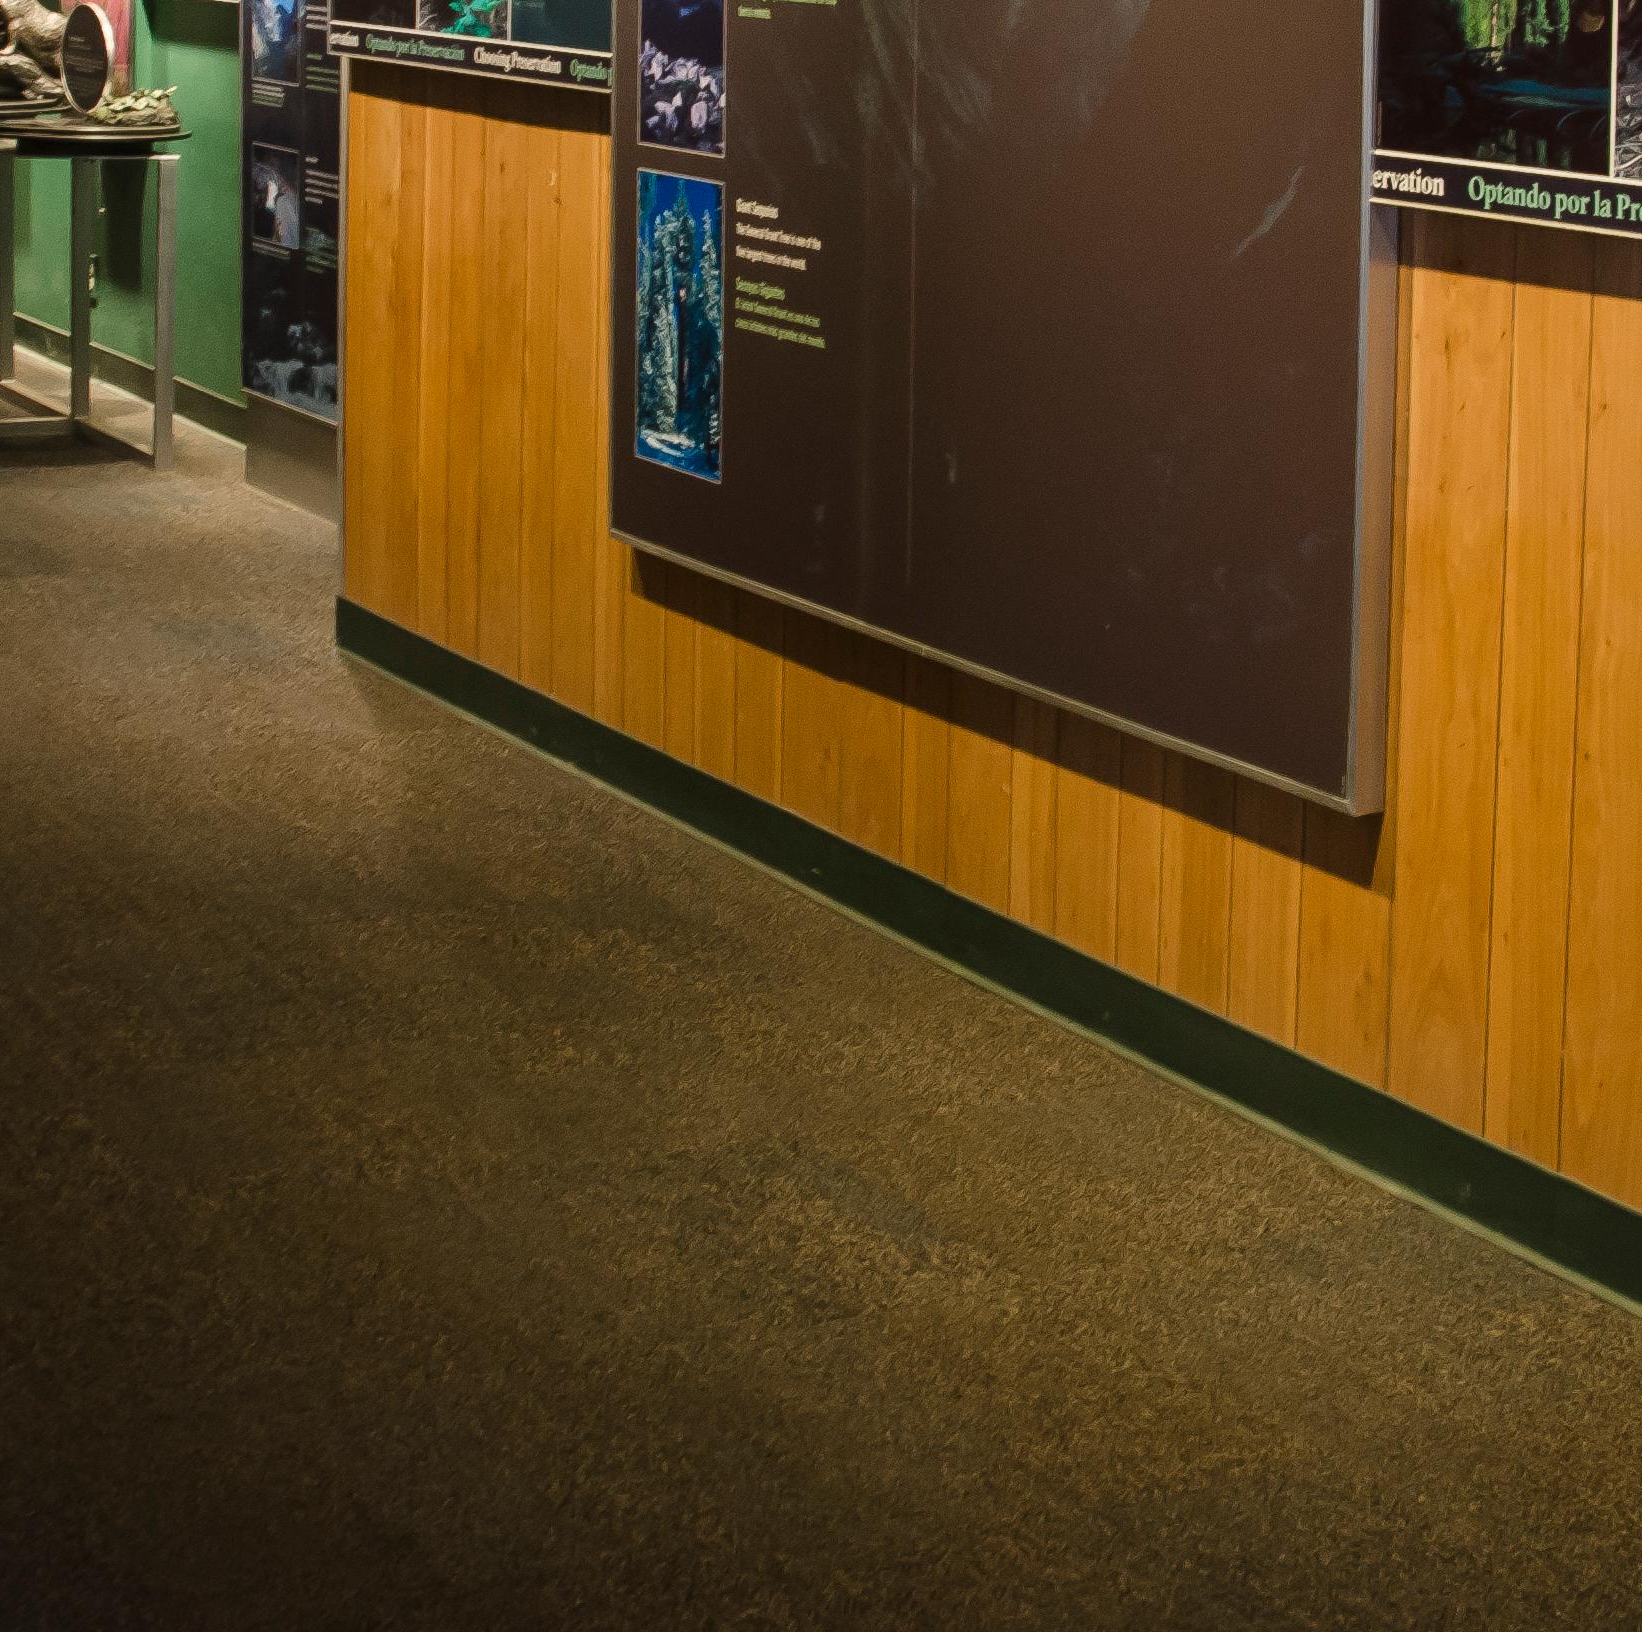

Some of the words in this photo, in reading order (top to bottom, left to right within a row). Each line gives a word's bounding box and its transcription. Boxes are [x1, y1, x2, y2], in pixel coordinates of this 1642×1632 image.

[1371, 168, 1445, 197] ervation
[1468, 175, 1549, 210] Optando
[1555, 189, 1590, 218] por
[1594, 188, 1612, 218] la
